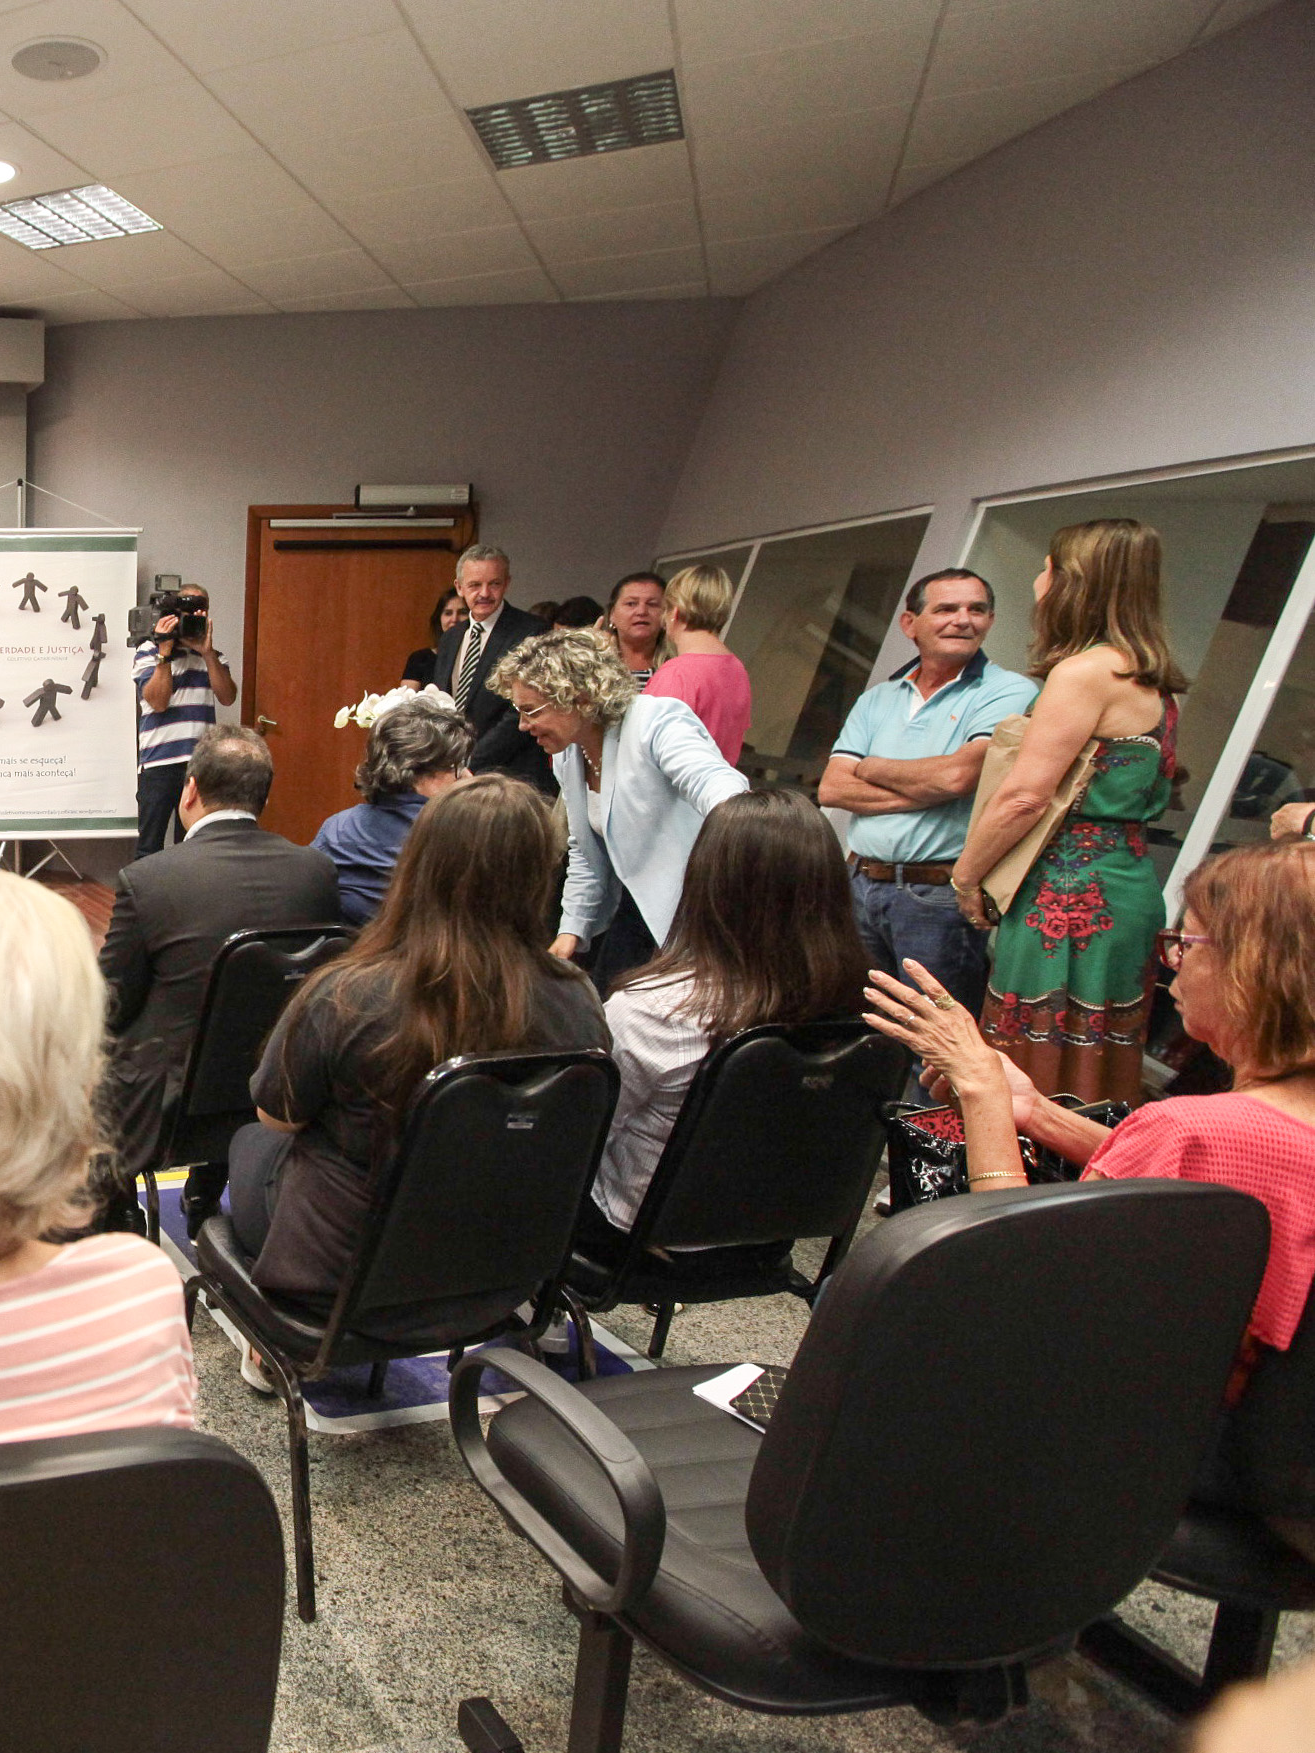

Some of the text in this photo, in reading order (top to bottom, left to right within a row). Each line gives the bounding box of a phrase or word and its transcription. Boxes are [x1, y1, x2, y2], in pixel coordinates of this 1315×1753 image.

[39, 646, 44, 654] E
[47, 645, 85, 656] JUSTIÇA
[30, 755, 67, 767] esqueça!
[14, 769, 34, 778] mais
[36, 768, 76, 778] aconteça!
